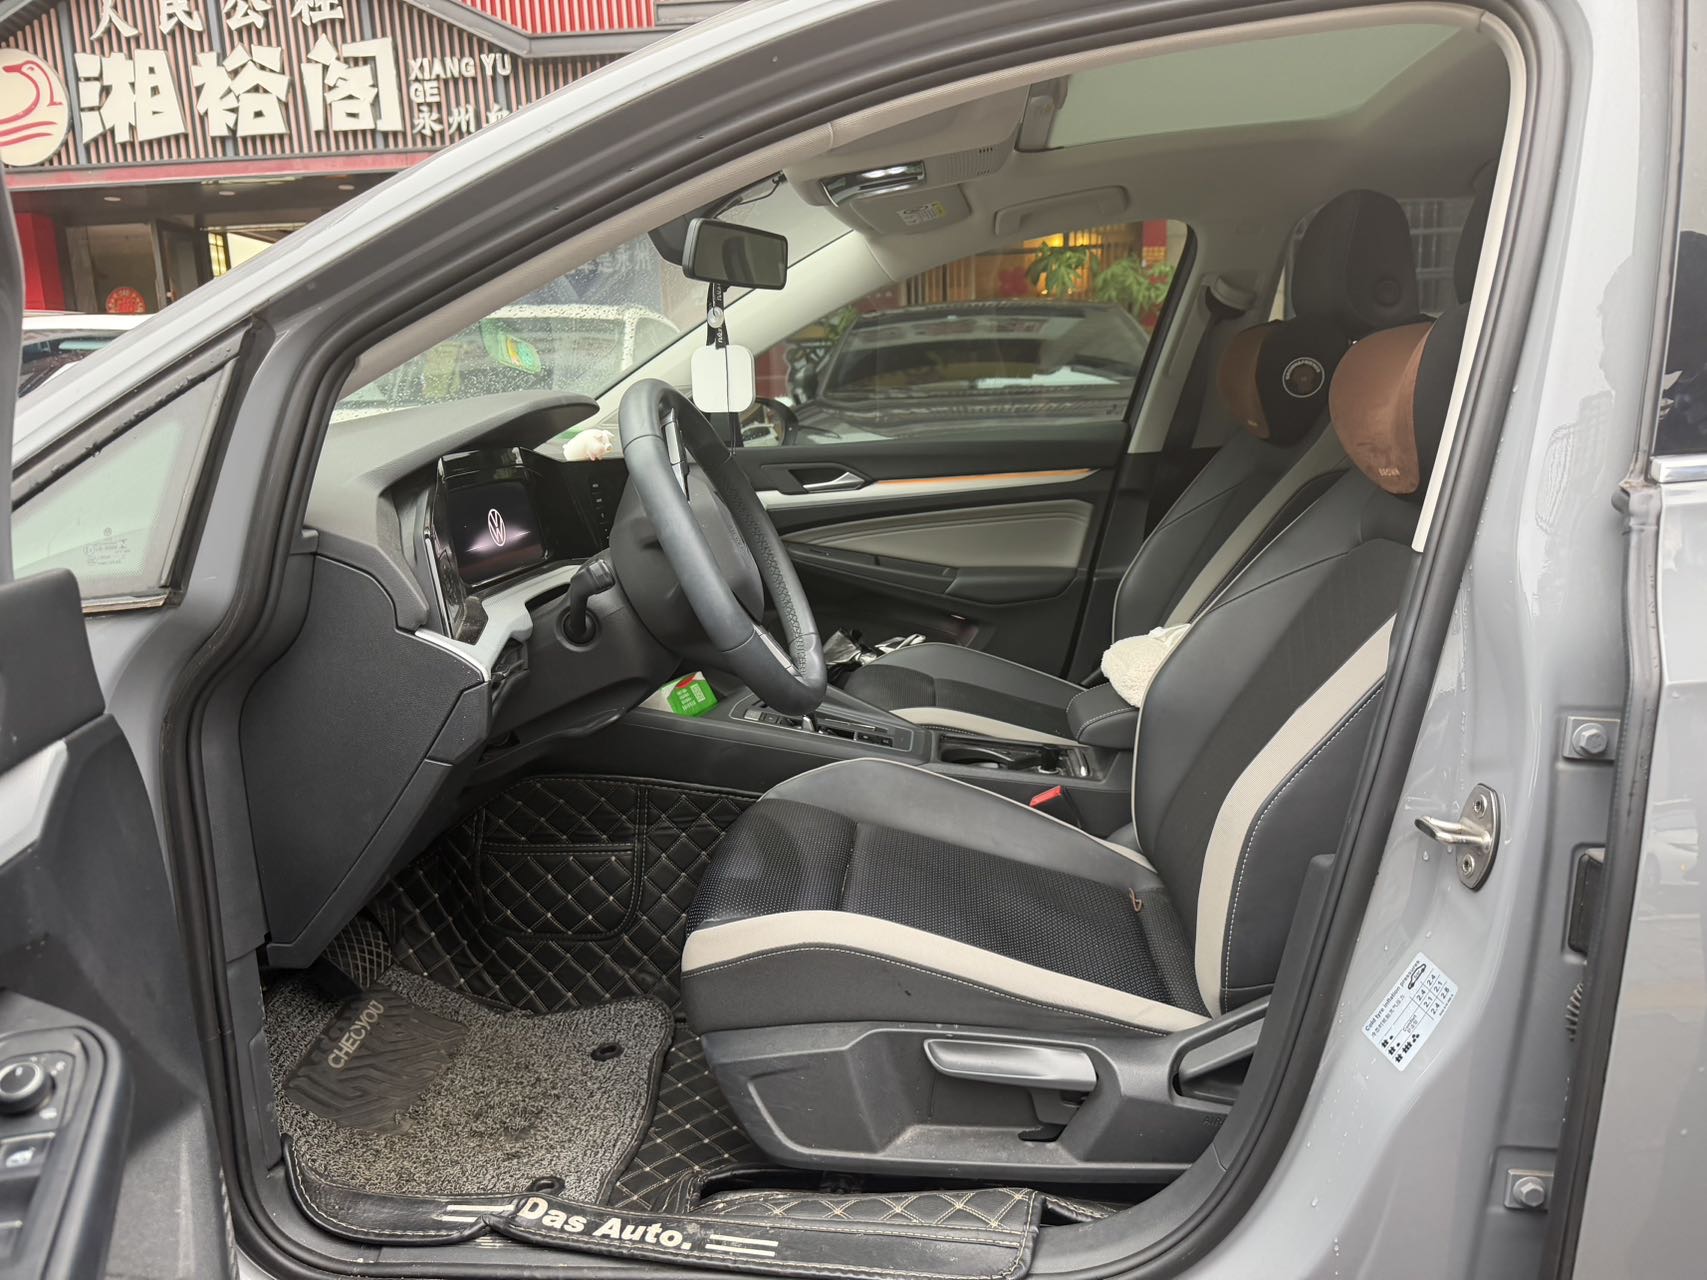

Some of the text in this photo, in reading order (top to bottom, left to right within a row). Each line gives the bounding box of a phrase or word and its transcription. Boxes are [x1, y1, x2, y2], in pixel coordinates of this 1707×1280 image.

[90, 0, 345, 41] 人民公社
[408, 53, 513, 81] XIANG YU
[73, 34, 405, 145] 湘裕阁
[409, 79, 441, 104] GE
[1365, 1017, 1376, 1031] Cold
[1376, 1008, 1384, 1019] tyre
[1384, 987, 1400, 1008] inflation
[1400, 960, 1420, 987] pressures
[1417, 974, 1435, 1001] 2.4 2.4
[1423, 997, 1432, 1008] 2.1
[1434, 981, 1443, 993] 2.1
[1431, 1003, 1439, 1015] 2.4
[517, 1196, 693, 1250] Das Auto.
